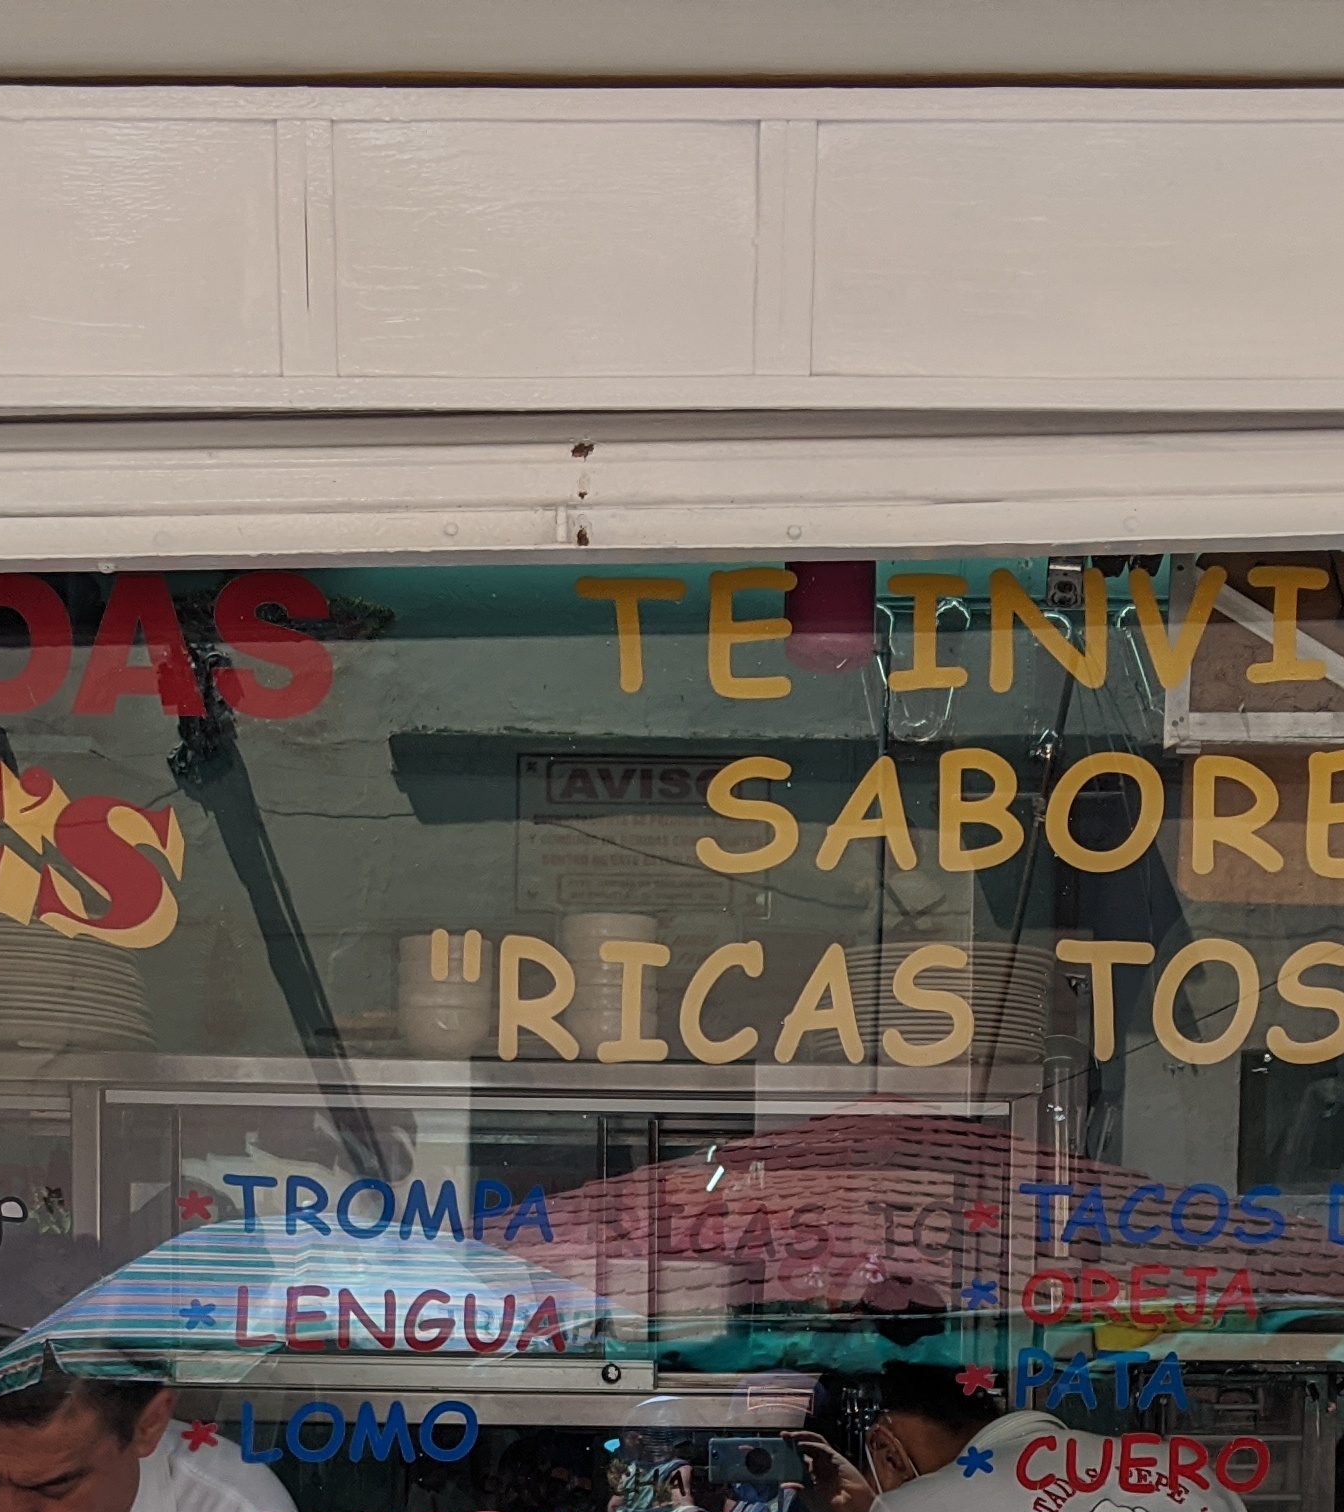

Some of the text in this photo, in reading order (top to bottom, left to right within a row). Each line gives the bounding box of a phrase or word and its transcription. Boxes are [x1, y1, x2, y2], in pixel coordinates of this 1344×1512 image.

[575, 567, 798, 699] TE
[431, 928, 975, 1067] "RICAS
[223, 1173, 554, 1243] TROMPA
[1019, 1182, 1286, 1247] TACOS
[235, 1284, 567, 1354] LENGUA
[1021, 1264, 1259, 1327] OREJA
[1014, 1347, 1189, 1411] PATA
[240, 1400, 480, 1464] LOMO
[1016, 1432, 1272, 1494] CUERO
